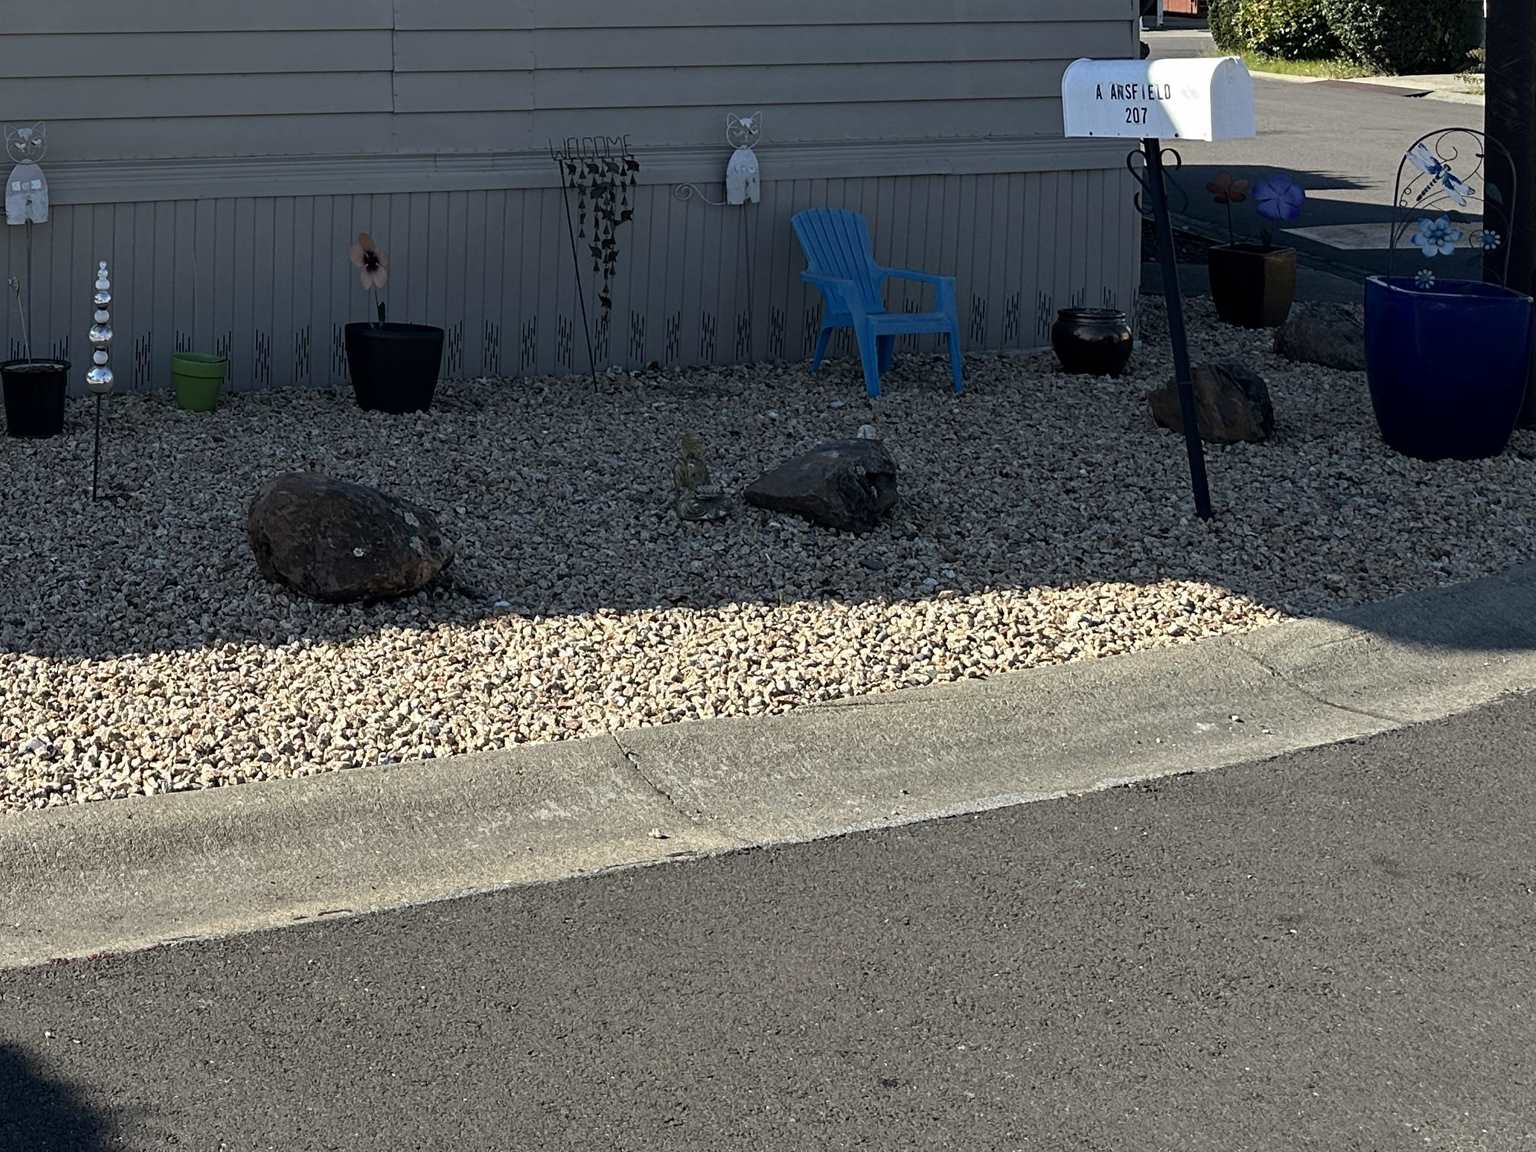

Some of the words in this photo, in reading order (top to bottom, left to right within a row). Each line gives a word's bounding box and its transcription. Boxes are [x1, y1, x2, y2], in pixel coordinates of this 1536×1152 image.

[1096, 83, 1104, 100] A
[1125, 107, 1148, 125] 207
[548, 134, 634, 160] WELCOME
